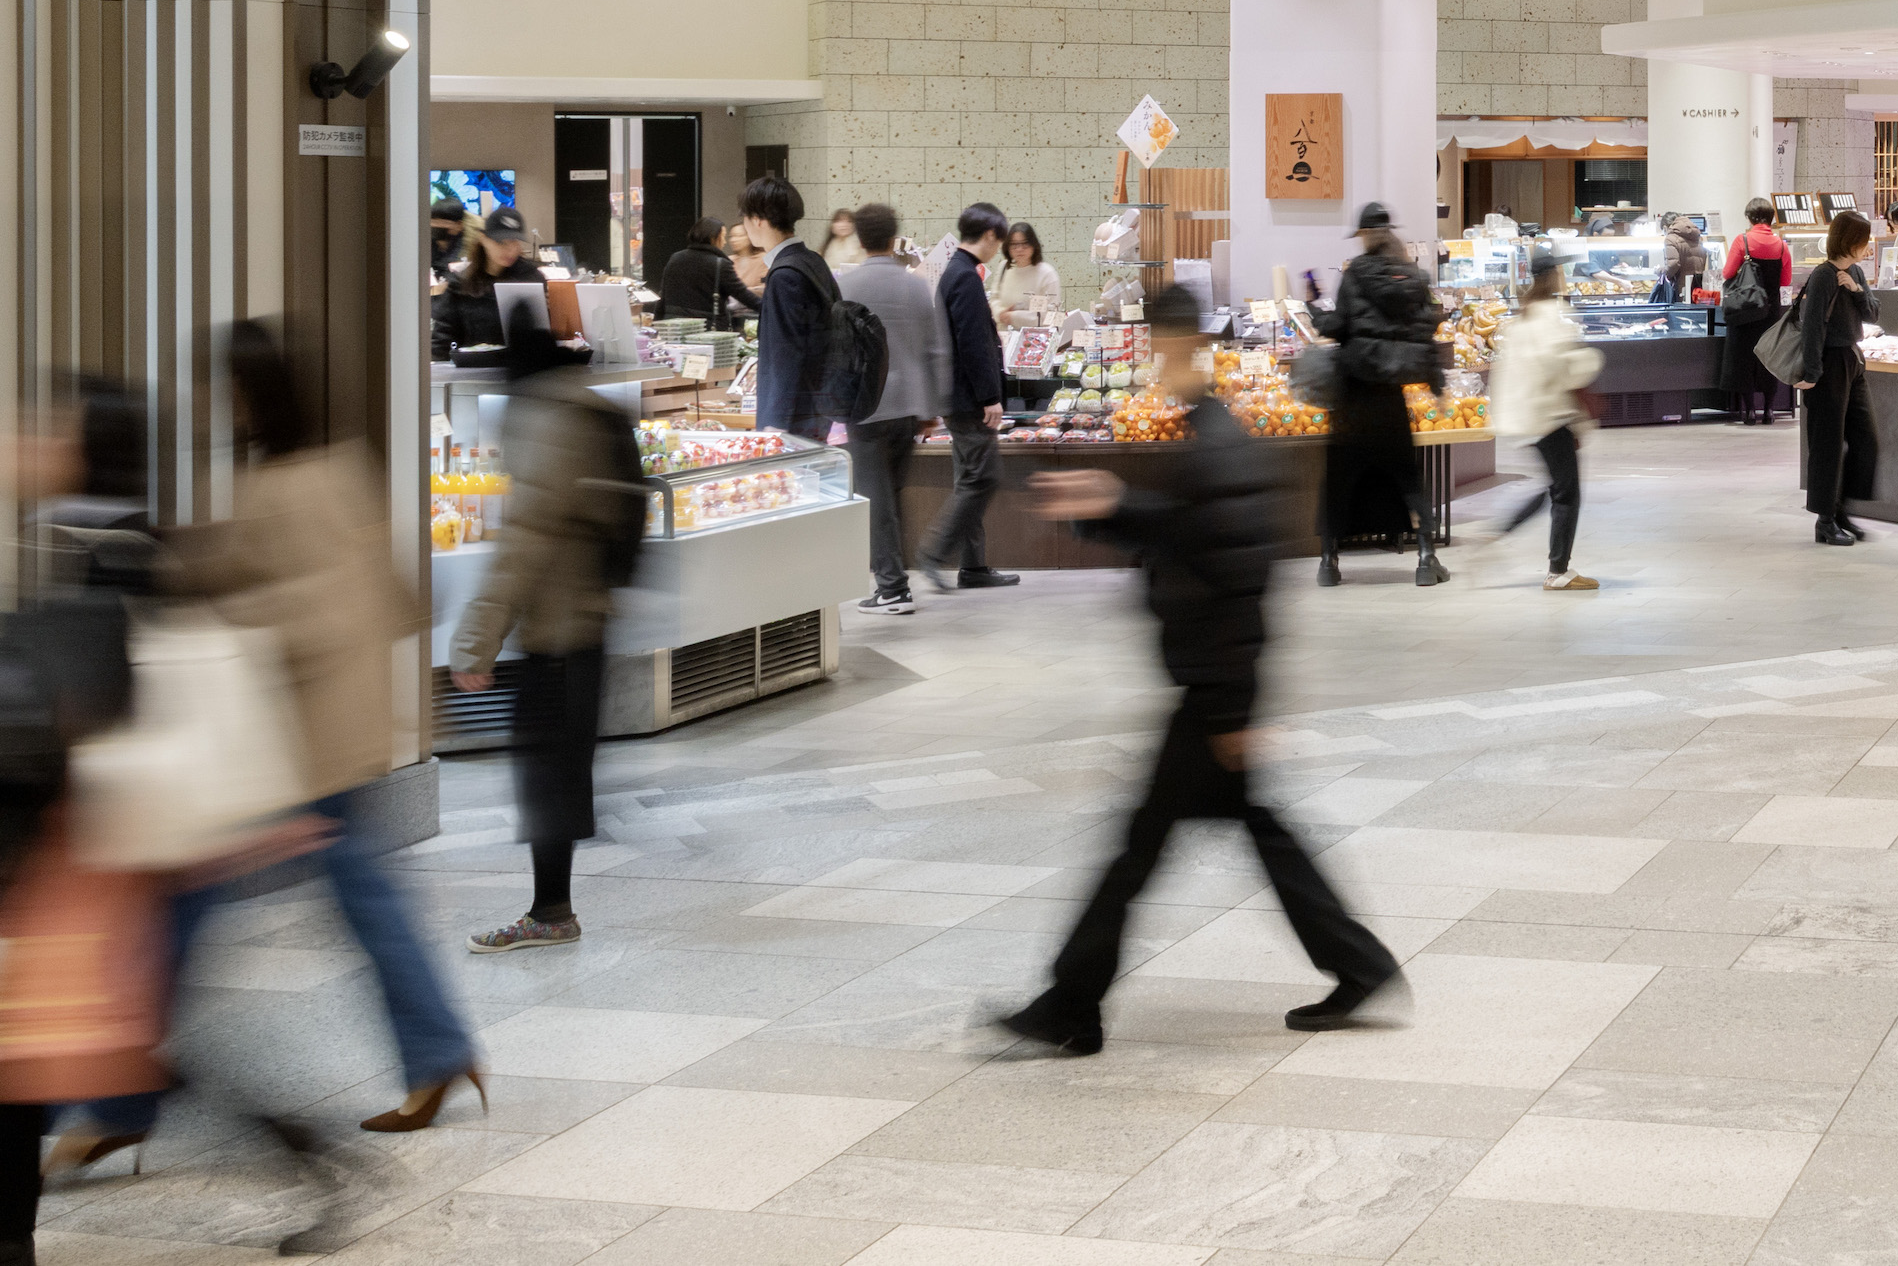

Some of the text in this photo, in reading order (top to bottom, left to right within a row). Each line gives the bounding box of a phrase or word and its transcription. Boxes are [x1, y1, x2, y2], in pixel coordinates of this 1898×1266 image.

[1689, 108, 1727, 118] CASHIER
[302, 130, 363, 143] 防犯カメラ監視中
